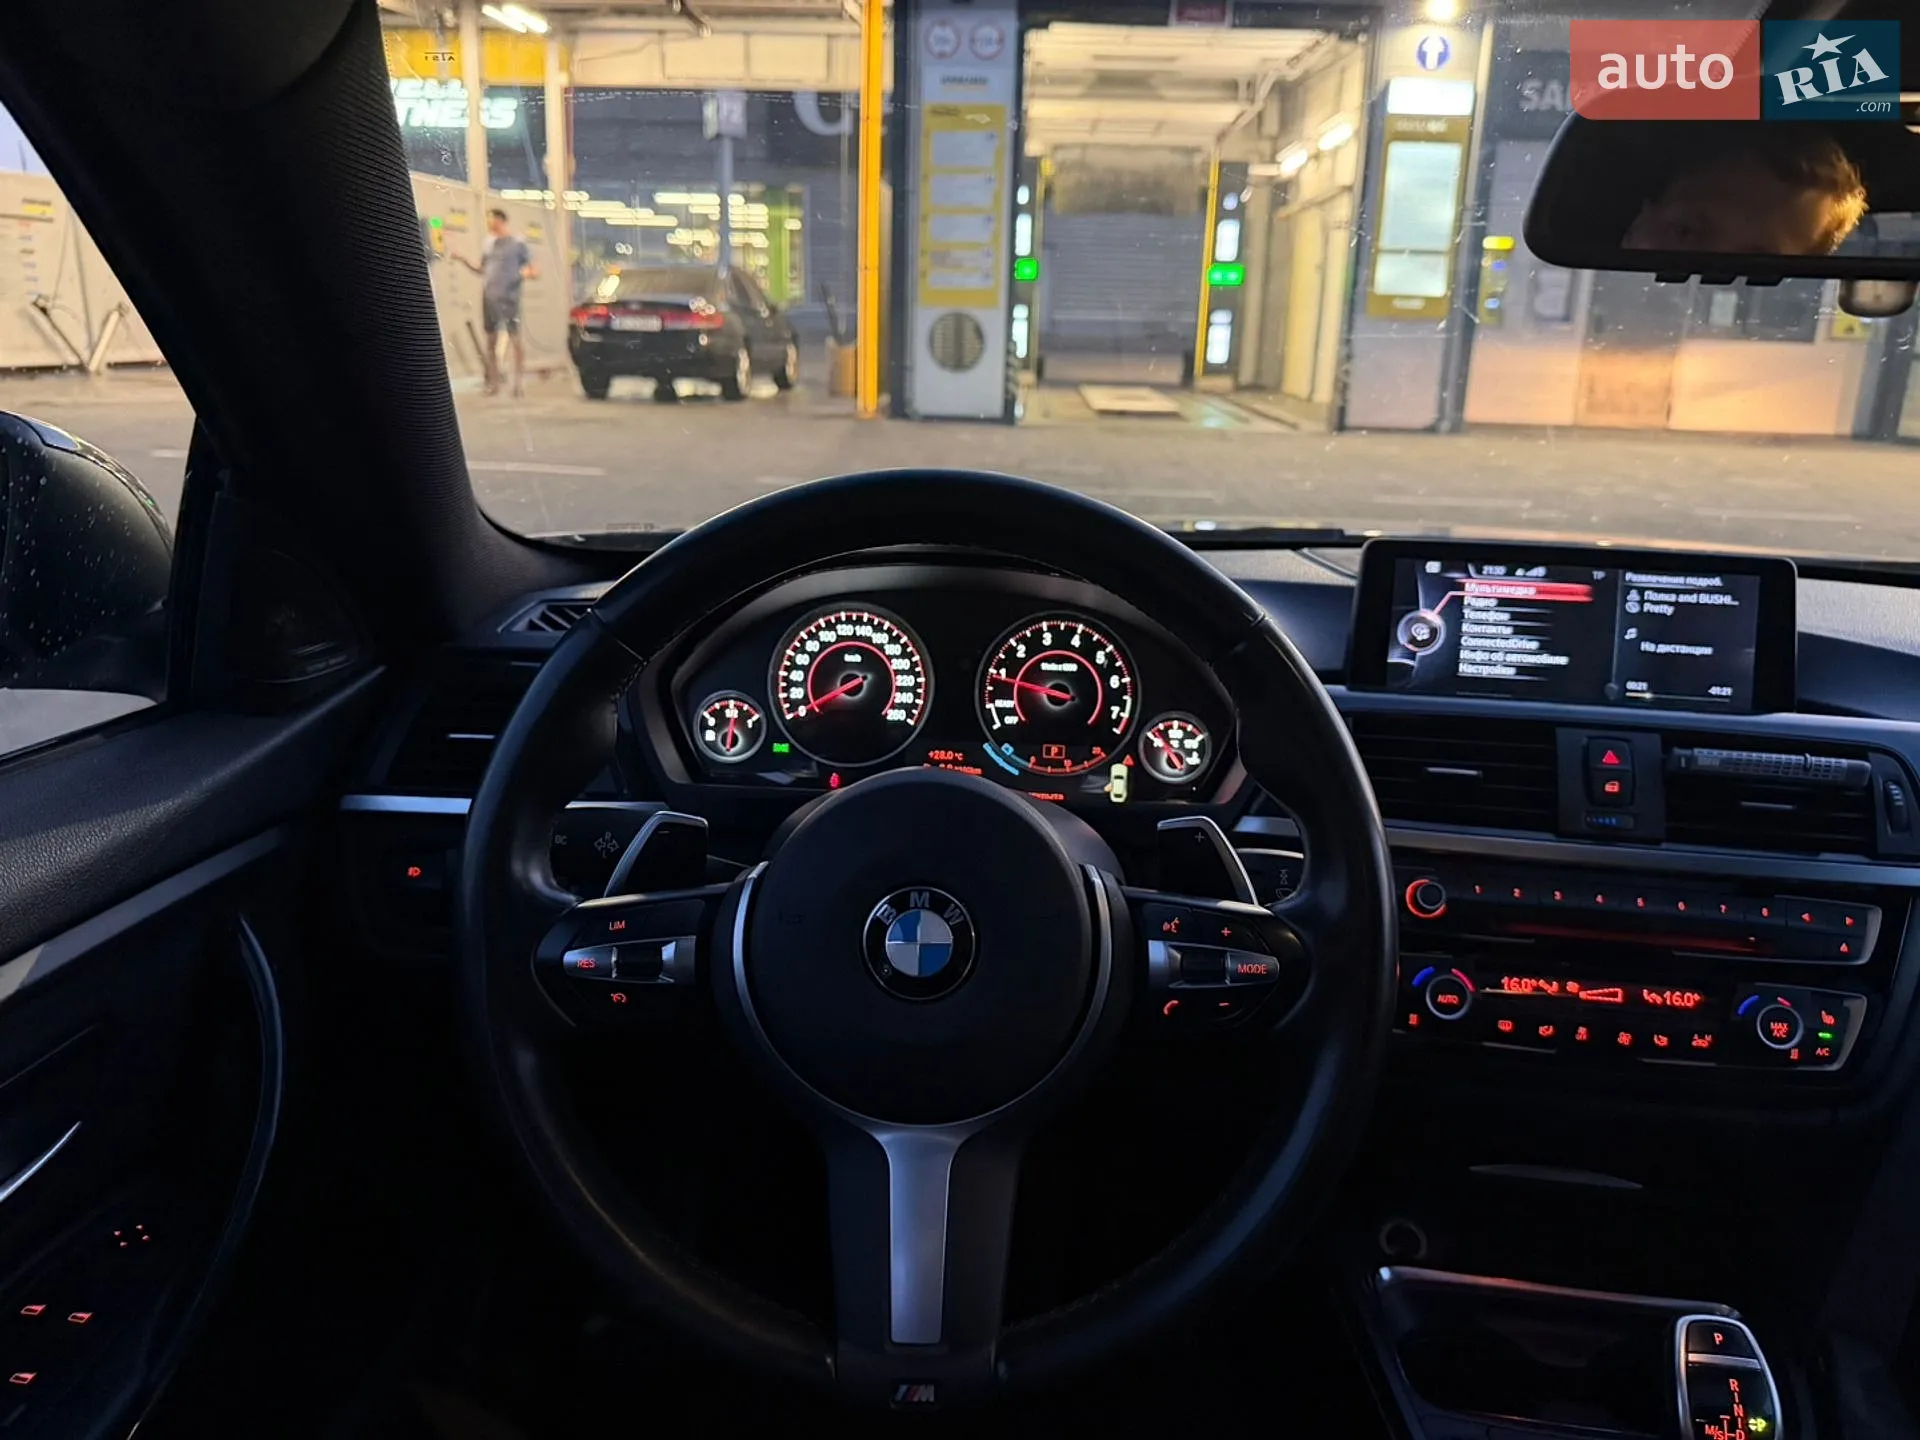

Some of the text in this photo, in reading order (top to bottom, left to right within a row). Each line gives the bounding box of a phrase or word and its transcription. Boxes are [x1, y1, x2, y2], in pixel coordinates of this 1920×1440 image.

[1465, 582, 1537, 597] Мультимедиа
[1464, 597, 1499, 608] Радио
[1643, 602, 1675, 616] Pretty
[1463, 610, 1511, 622] Телефон
[836, 624, 854, 636] 120
[855, 625, 873, 637] 140
[1462, 623, 1514, 635] Контакты
[818, 630, 837, 643] 100
[871, 633, 889, 644] 160
[1042, 631, 1053, 646] 3
[1071, 633, 1082, 648] 4
[805, 640, 820, 652] 80
[1461, 636, 1540, 650] ConnectedDrive
[1640, 641, 1656, 652] На
[883, 643, 902, 656] 180
[1016, 644, 1027, 658] 2
[795, 653, 810, 666] 60
[1095, 650, 1107, 665] 5
[1460, 650, 1570, 666] Инфо об автомобиле
[890, 658, 911, 671] 200
[1459, 663, 1517, 676] Настройки
[789, 669, 805, 682] 40
[999, 667, 1007, 680] 1
[894, 674, 915, 687] 220
[1109, 674, 1121, 689] 6
[789, 686, 805, 699] 20
[893, 691, 914, 704] 240
[798, 705, 807, 717] 0
[1110, 705, 1121, 720] 7
[1004, 715, 1020, 725] OFF
[928, 750, 955, 761] +28.0
[1050, 746, 1059, 757] P
[1474, 884, 1482, 894] 1
[1513, 888, 1522, 898] 2
[1553, 890, 1563, 900] 3
[1596, 894, 1604, 904] 4
[1636, 897, 1645, 908] 5
[876, 891, 965, 926] BMW
[1677, 901, 1687, 911] 6
[1719, 904, 1728, 914] 7
[608, 920, 626, 931] LIM
[576, 958, 596, 969] RES
[1237, 963, 1268, 975] MODE
[1436, 994, 1460, 1005] AUTO
[1770, 1021, 1789, 1031] MAX
[1815, 1047, 1831, 1057] A/C
[1713, 1333, 1723, 1345] P
[1729, 1378, 1740, 1392] R
[1733, 1403, 1744, 1417] N
[1735, 1429, 1746, 1440] D
